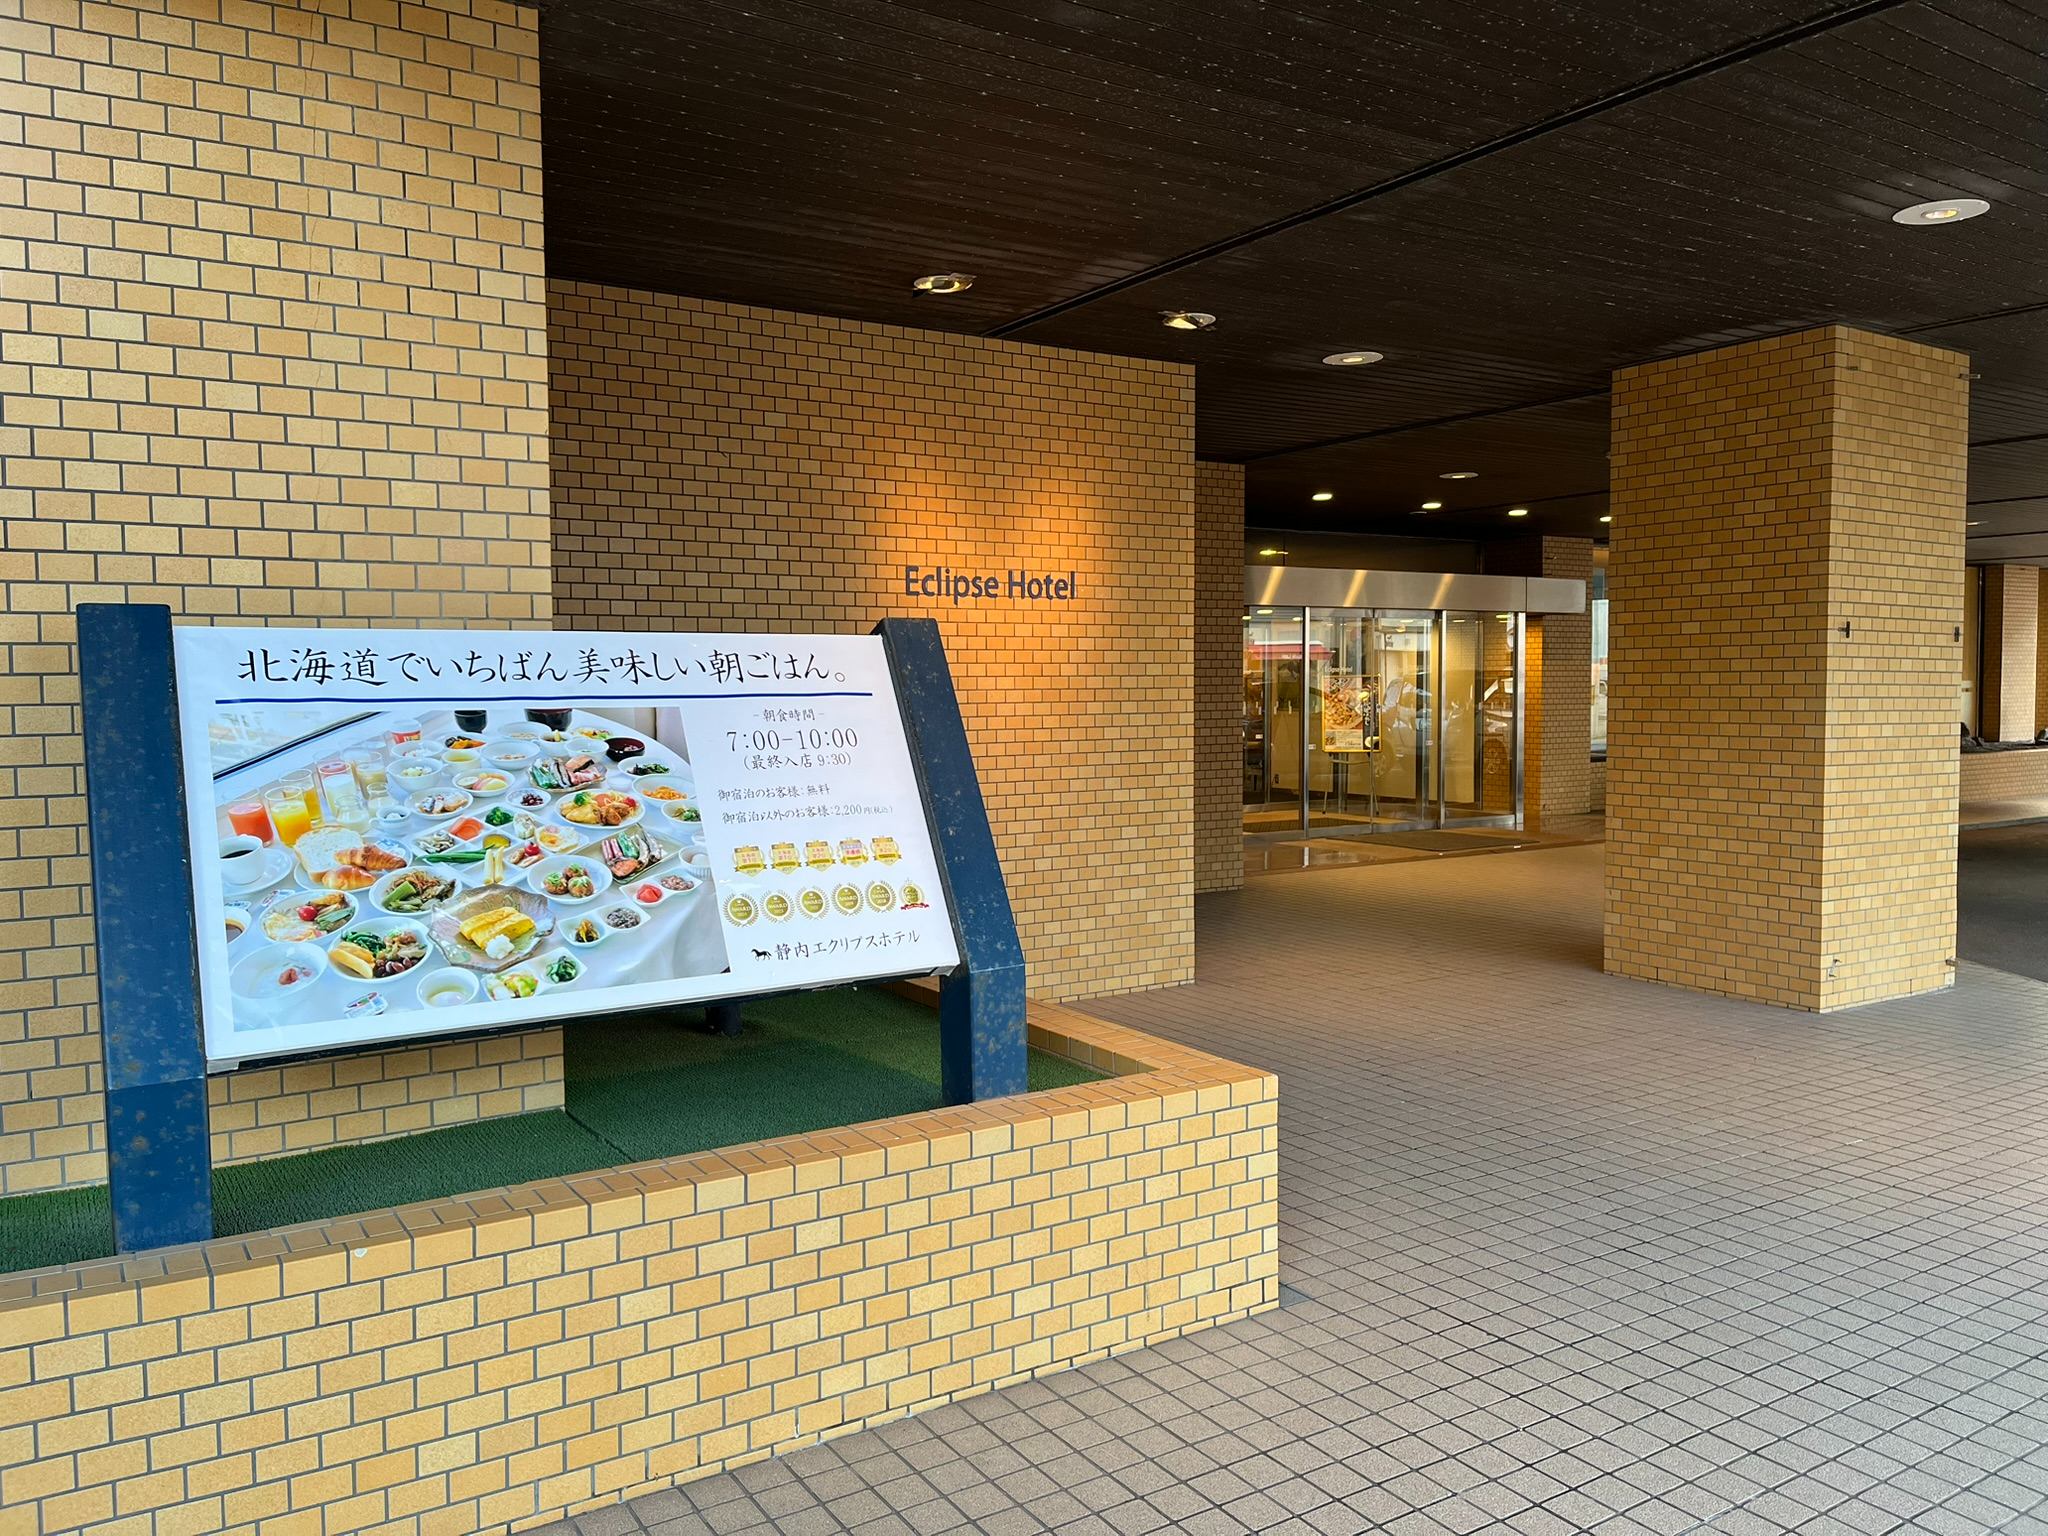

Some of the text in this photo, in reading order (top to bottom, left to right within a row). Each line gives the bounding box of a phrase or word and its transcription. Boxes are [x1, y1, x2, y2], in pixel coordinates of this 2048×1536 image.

[905, 566, 1076, 606] Eclipse Hotel
[237, 647, 847, 687] 北海道でいちばん美味しい朝ごはん。
[774, 929, 921, 960] 静内エクリプスホテル
